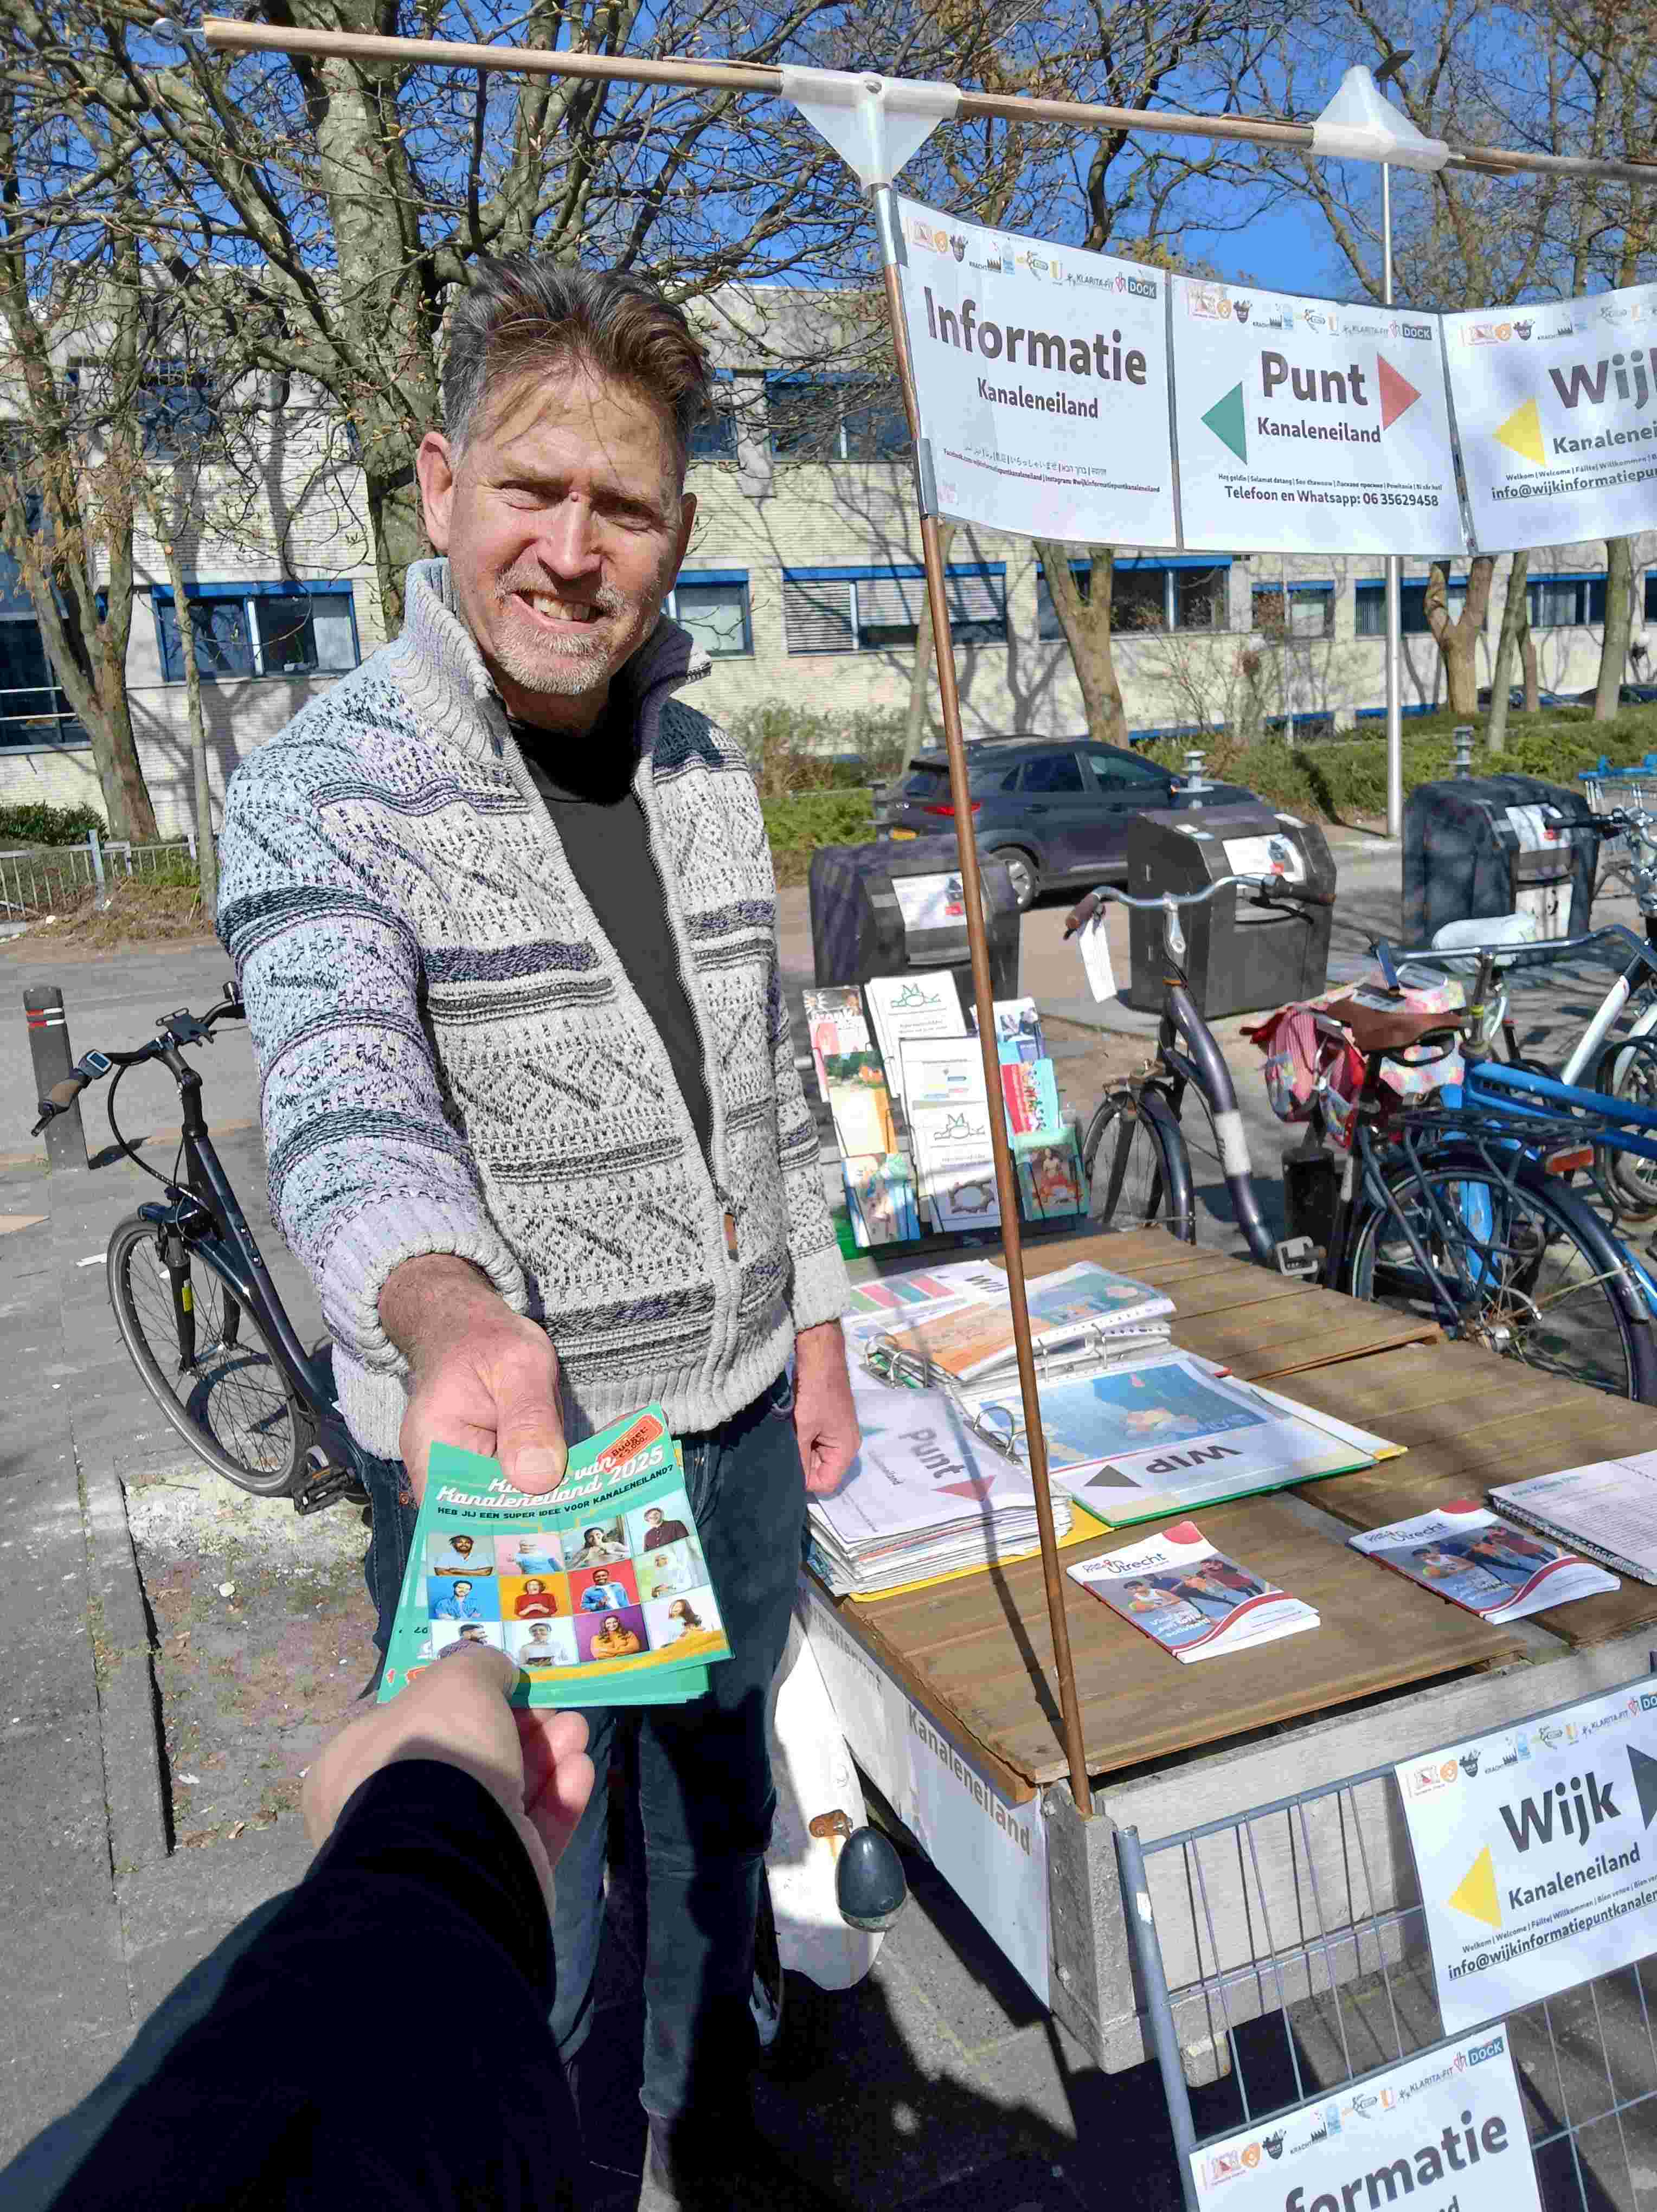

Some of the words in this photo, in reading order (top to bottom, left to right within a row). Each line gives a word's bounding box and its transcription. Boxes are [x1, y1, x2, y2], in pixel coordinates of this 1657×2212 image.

[1129, 281, 1155, 297] DOCK
[924, 286, 1148, 385] Informatie
[1404, 329, 1431, 339] DOCK
[977, 377, 1099, 419] Kanaleneiland
[1262, 350, 1368, 406] Punt
[1549, 347, 1657, 410] Wij
[1258, 416, 1381, 443] Kanaleneiland
[1539, 468, 1571, 477] Welcome
[1224, 486, 1277, 501] Telefoon
[1281, 491, 1295, 501] en
[1297, 490, 1360, 507] Whatsapp:
[1363, 492, 1379, 504] 06
[1380, 493, 1439, 506] 35629458
[575, 1457, 616, 1480] van
[607, 1444, 663, 1486] 2025
[898, 1427, 965, 1479] Punt
[438, 1507, 458, 1516] HEB
[538, 1507, 561, 1517] IDEE
[564, 1500, 590, 1512] VOOR
[593, 1464, 673, 1504] KANALENEILAND?
[907, 1702, 1032, 1856] Kanaleneiland
[1499, 1771, 1622, 1854] Wijk
[1509, 1842, 1641, 1910] Kanaleneiland
[1462, 1939, 1492, 1953] Welkom
[1496, 1925, 1528, 1941] Welcome
[1553, 1900, 1594, 1920] Willkommen
[1470, 2043, 1502, 2063] DOCK
